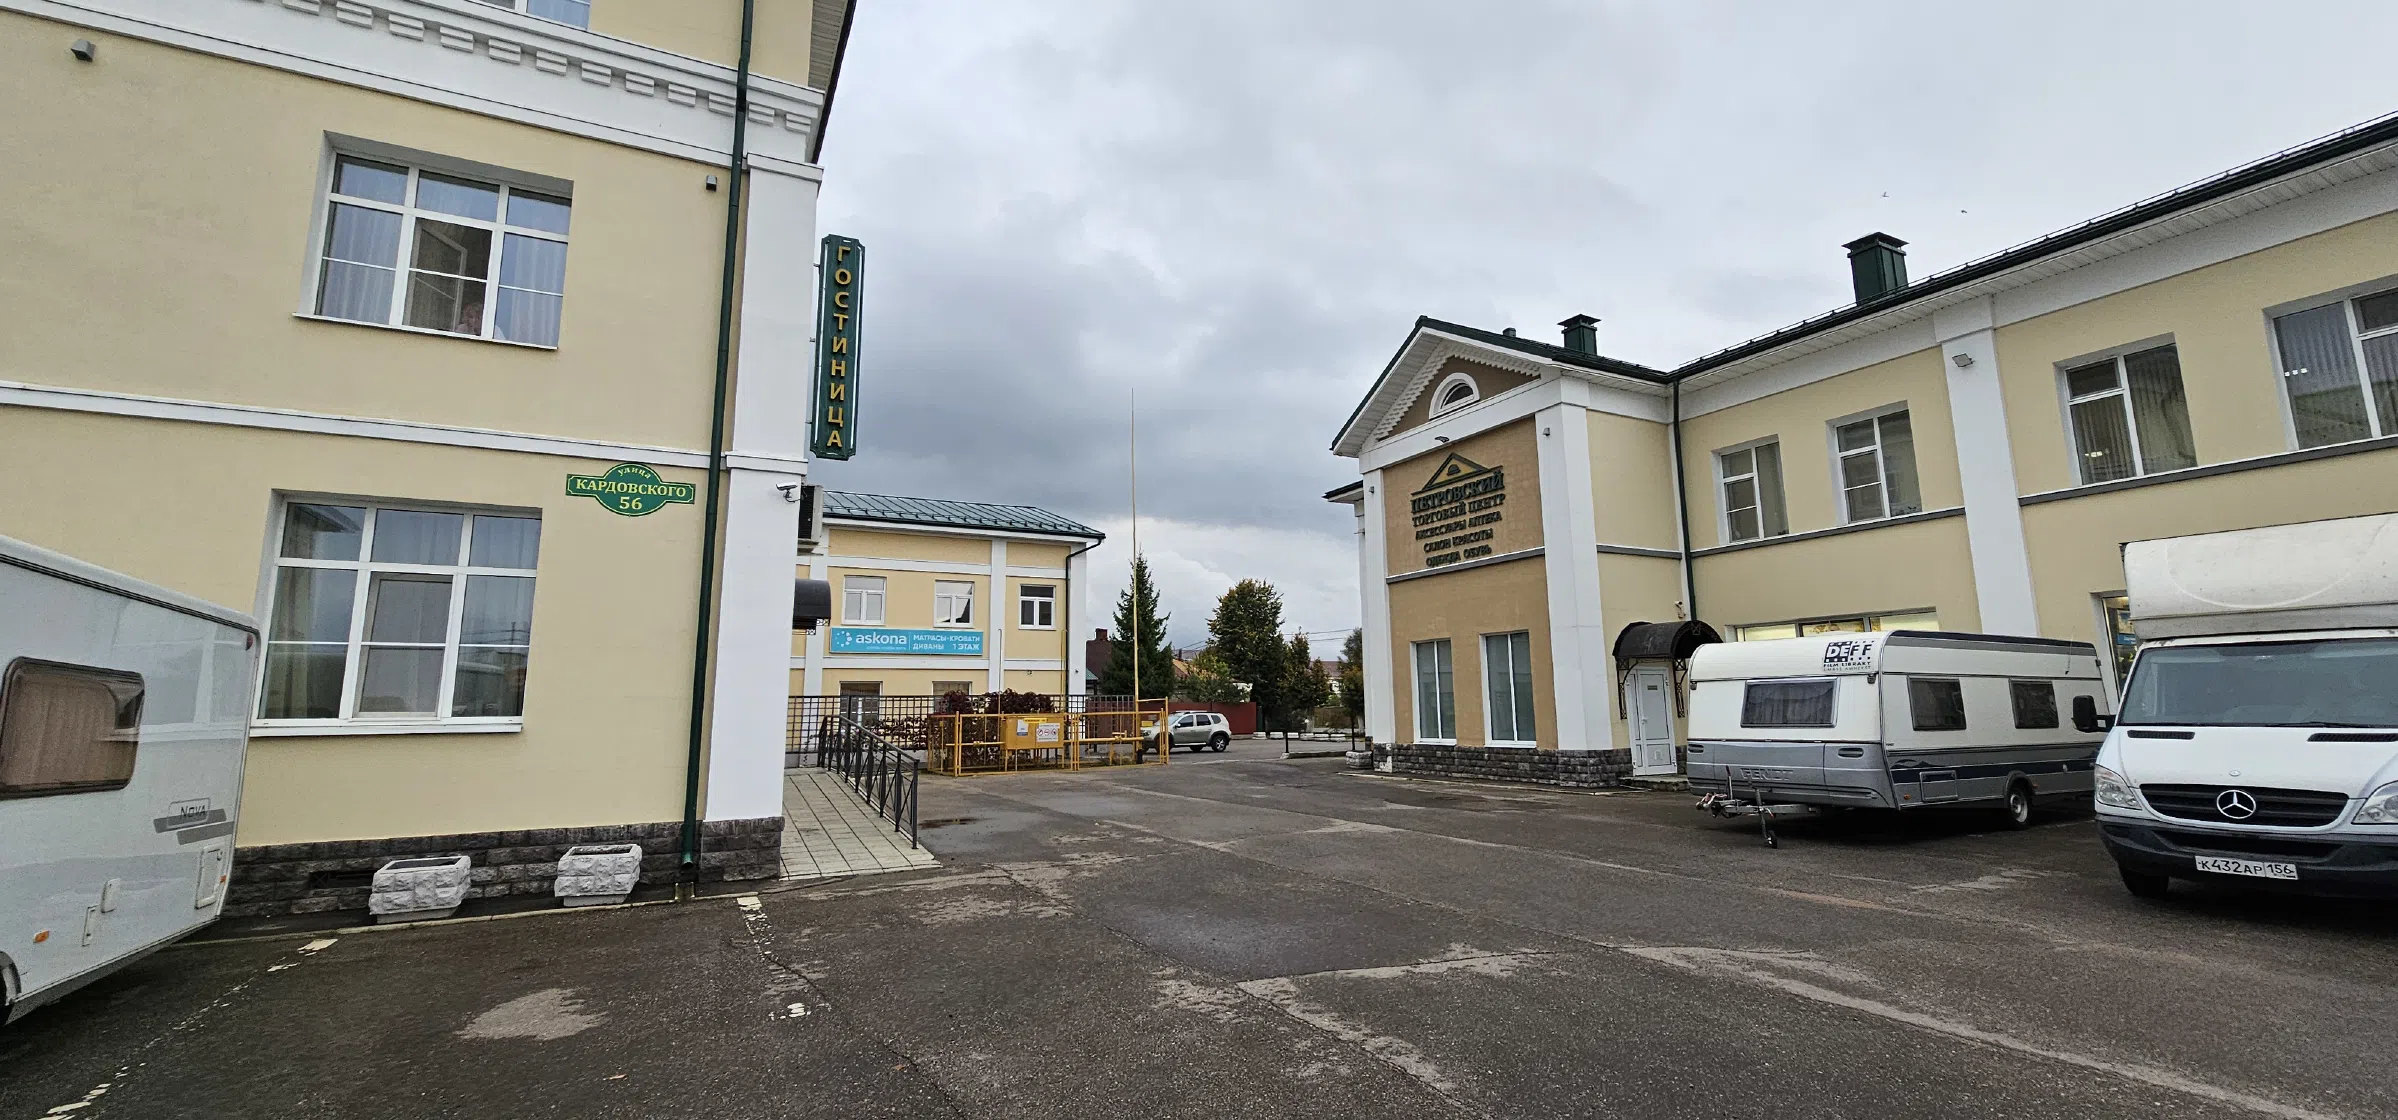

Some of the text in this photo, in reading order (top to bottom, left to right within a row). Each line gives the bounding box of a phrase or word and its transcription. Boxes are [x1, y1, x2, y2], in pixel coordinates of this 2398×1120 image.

[827, 246, 852, 448] ГОСТИНИЦА
[617, 467, 651, 479] улица
[575, 478, 687, 498] КАРДОВСКОГО
[1410, 470, 1506, 514] ПЕТРОВСКИЙ
[619, 496, 643, 510] 56
[1411, 493, 1506, 527] ТОРГОВЫЙ ЦЕНТР
[1423, 528, 1494, 553] САЛОН КРАСОТЫ
[1463, 544, 1492, 559] ОБУВЬ
[855, 631, 907, 645] askona
[1826, 644, 1873, 658] DEFF
[181, 805, 206, 818] NOVA
[2266, 864, 2295, 875] 156
